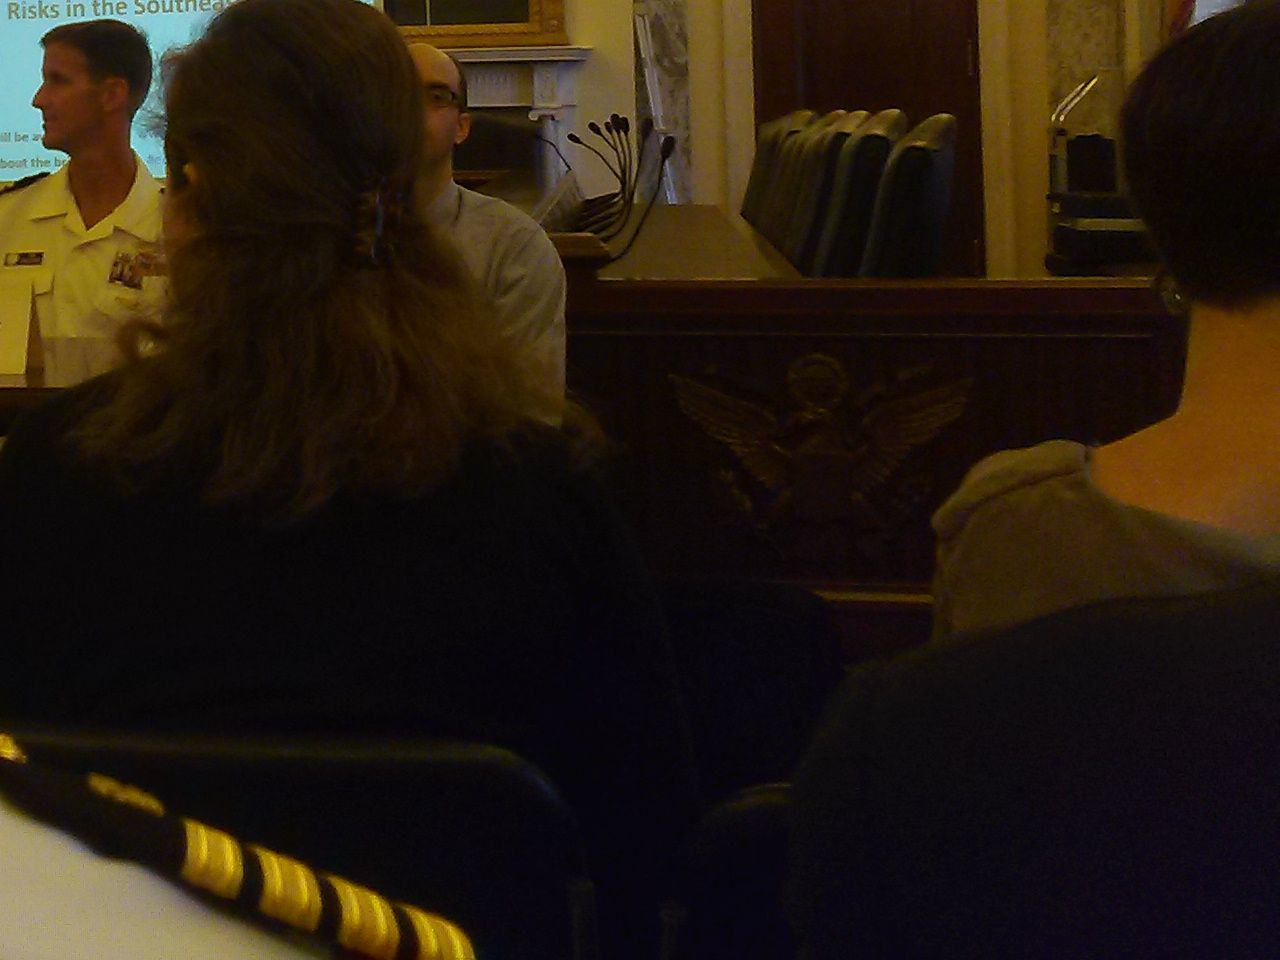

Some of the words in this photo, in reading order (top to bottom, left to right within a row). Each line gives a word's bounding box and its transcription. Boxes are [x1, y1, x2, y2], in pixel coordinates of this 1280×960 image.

[8, 0, 60, 20] Risks
[14, 132, 29, 143] be
[30, 157, 51, 168] the
